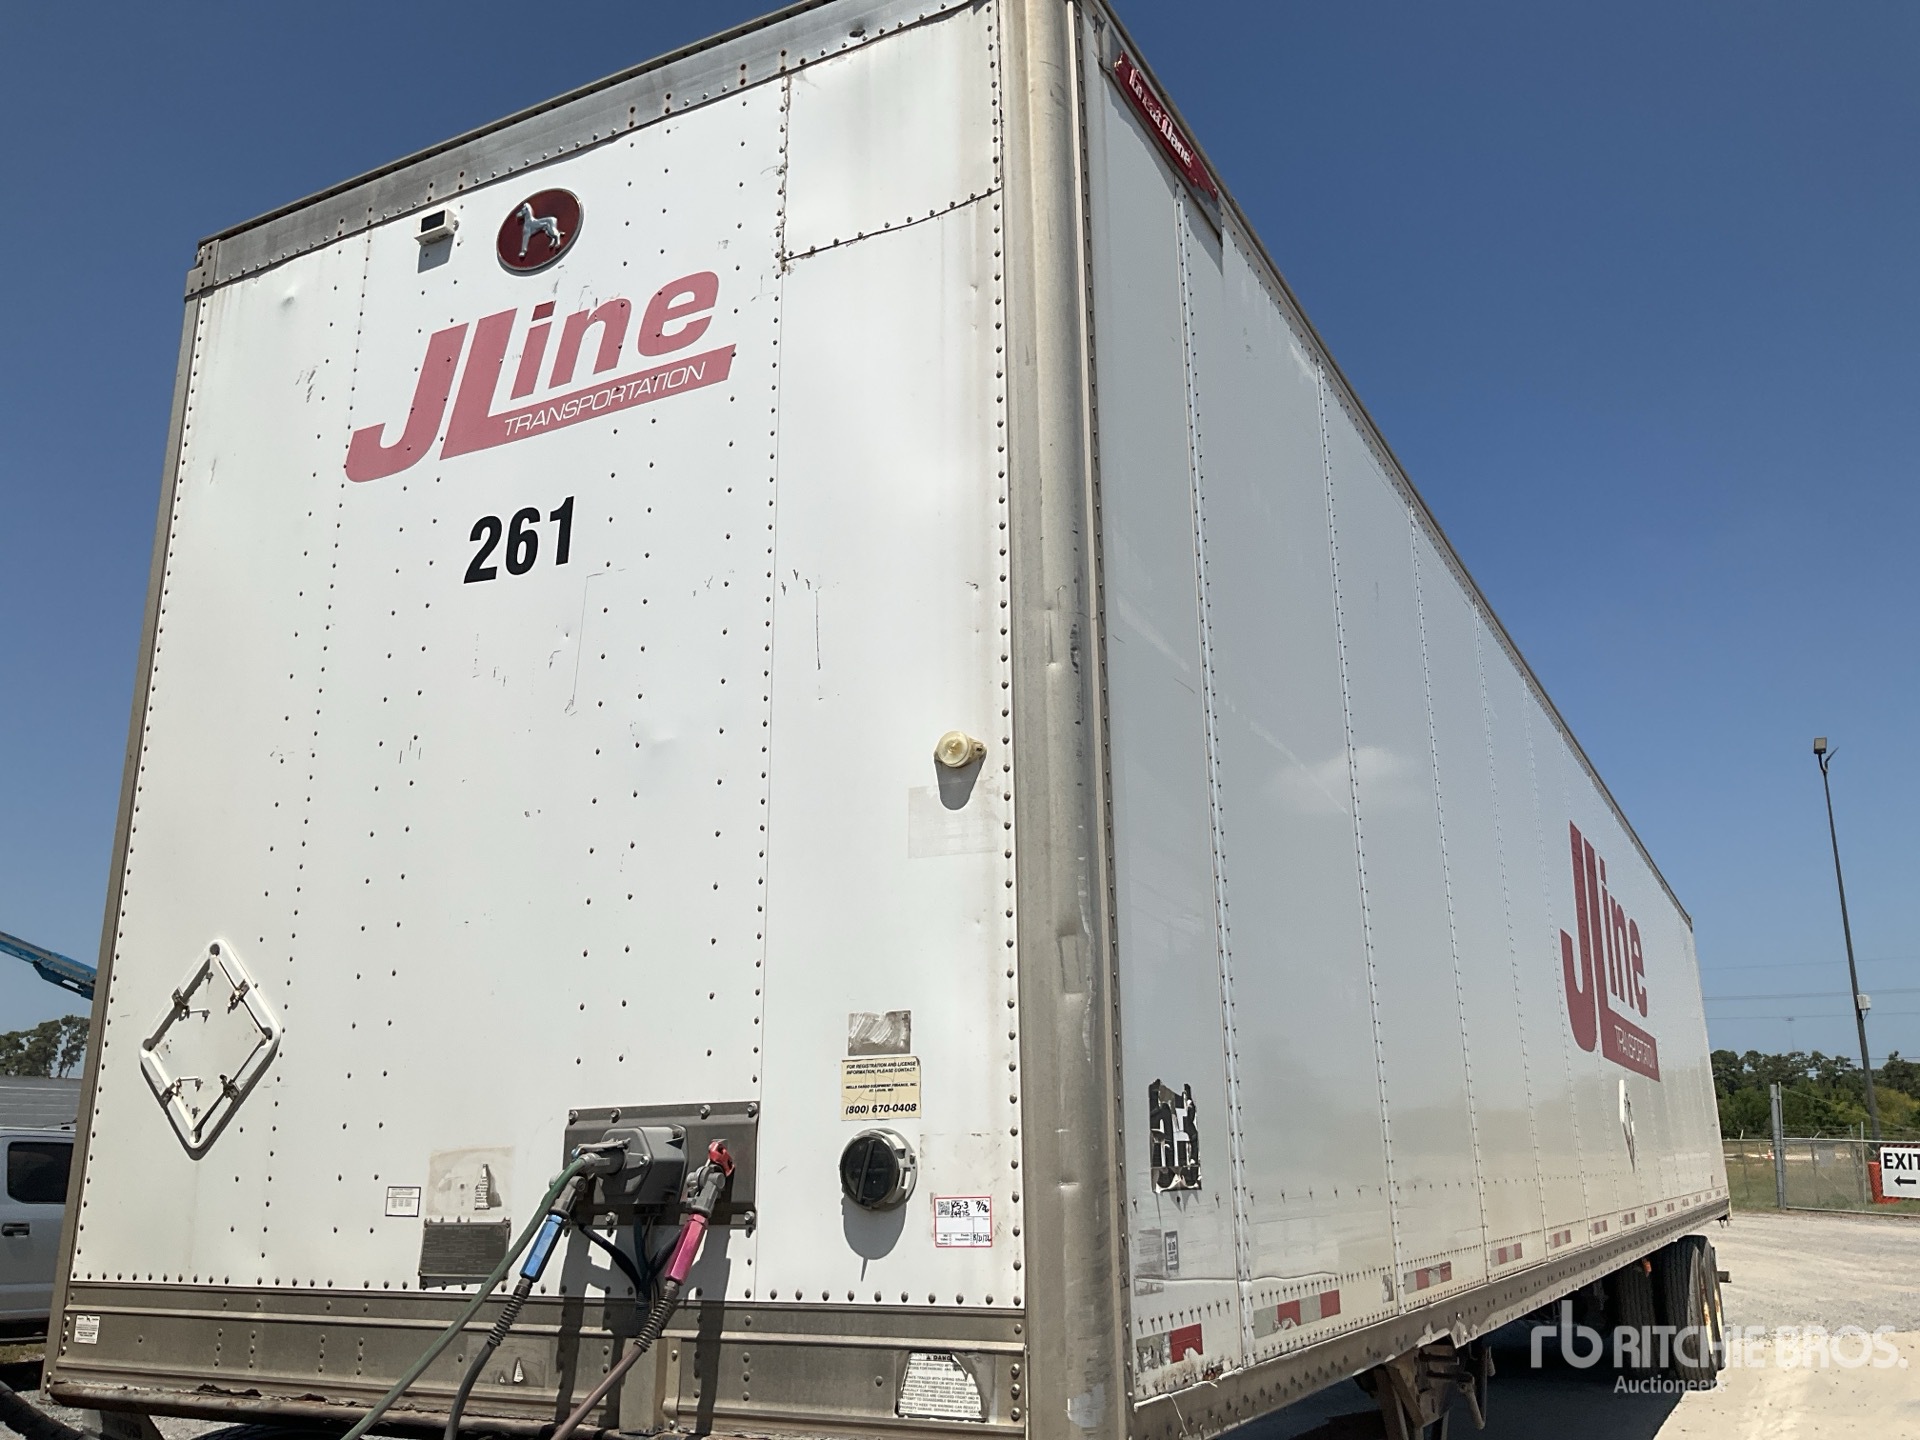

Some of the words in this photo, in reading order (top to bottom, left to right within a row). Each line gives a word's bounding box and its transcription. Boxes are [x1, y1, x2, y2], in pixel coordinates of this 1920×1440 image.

[504, 362, 706, 437] TRANSPORTATION
[463, 496, 575, 584] 261
[846, 1105, 870, 1115] (800)
[871, 1103, 917, 1114] 670-0408
[1883, 1152, 1920, 1170] EXIT
